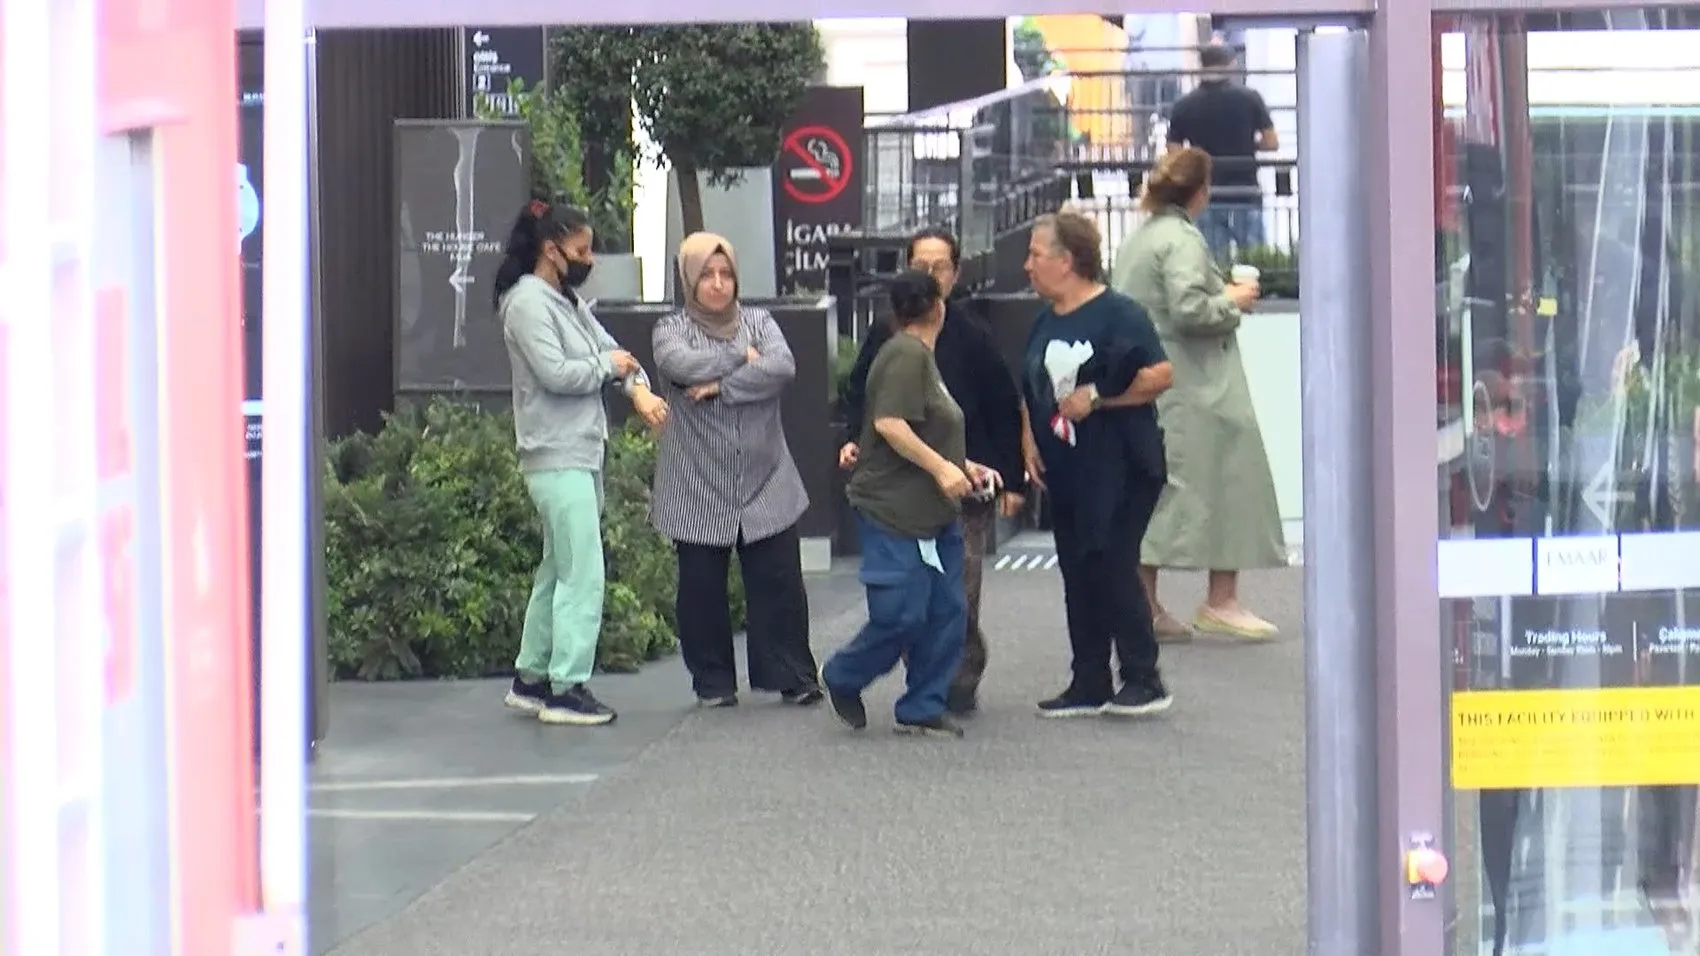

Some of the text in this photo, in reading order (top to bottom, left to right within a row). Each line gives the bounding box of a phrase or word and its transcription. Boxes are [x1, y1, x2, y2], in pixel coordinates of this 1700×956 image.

[1525, 629, 1607, 646] Trading Hours
[1457, 706, 1696, 727] THIS FACILITY EQUIPPED WITH
